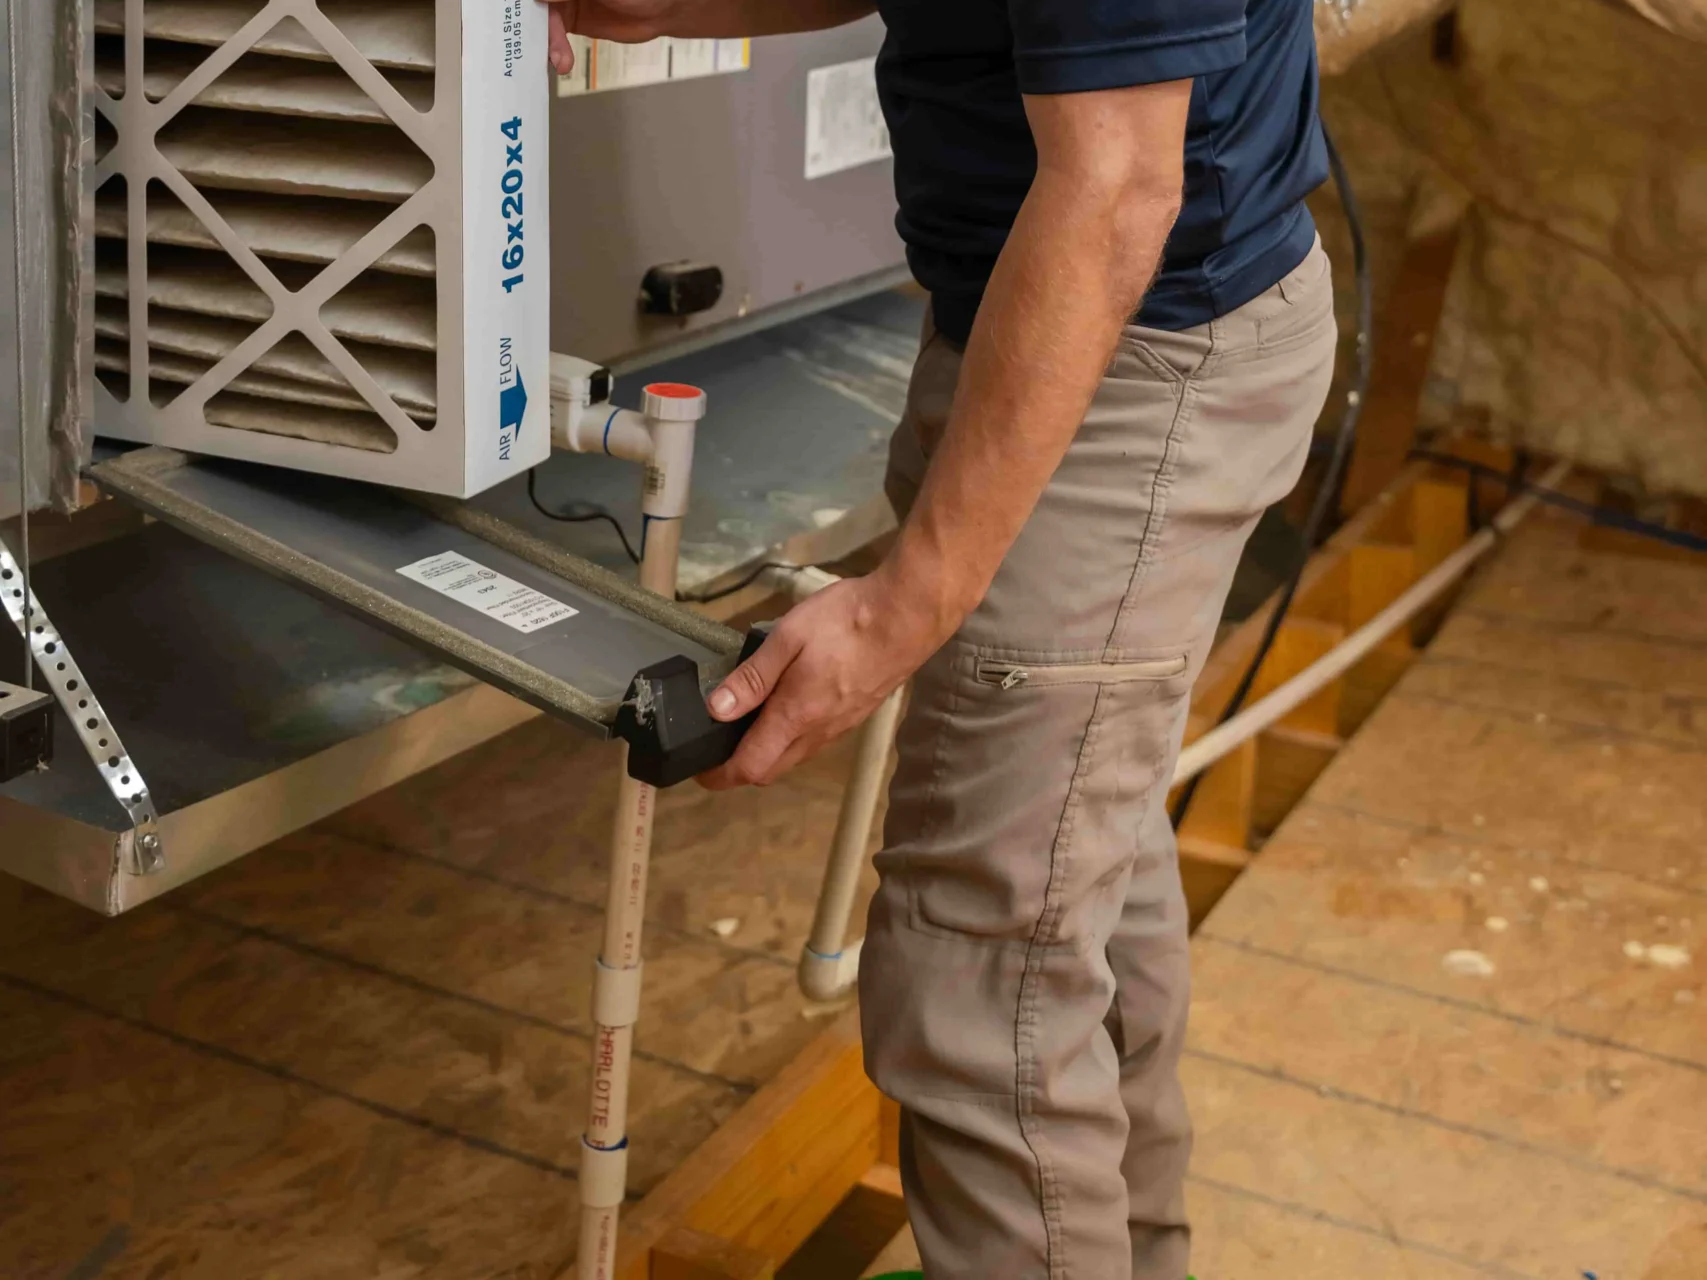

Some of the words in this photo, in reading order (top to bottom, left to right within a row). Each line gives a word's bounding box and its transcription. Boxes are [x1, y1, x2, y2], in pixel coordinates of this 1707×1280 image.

[503, 5, 512, 33] Size
[514, 0, 521, 17] cm
[503, 37, 513, 77] Actual
[513, 21, 523, 60] (39.05
[500, 116, 524, 294] 16x20x4
[499, 337, 512, 385] FLOW
[499, 431, 511, 460] AIR
[592, 1024, 615, 1128] HARLOTTE
